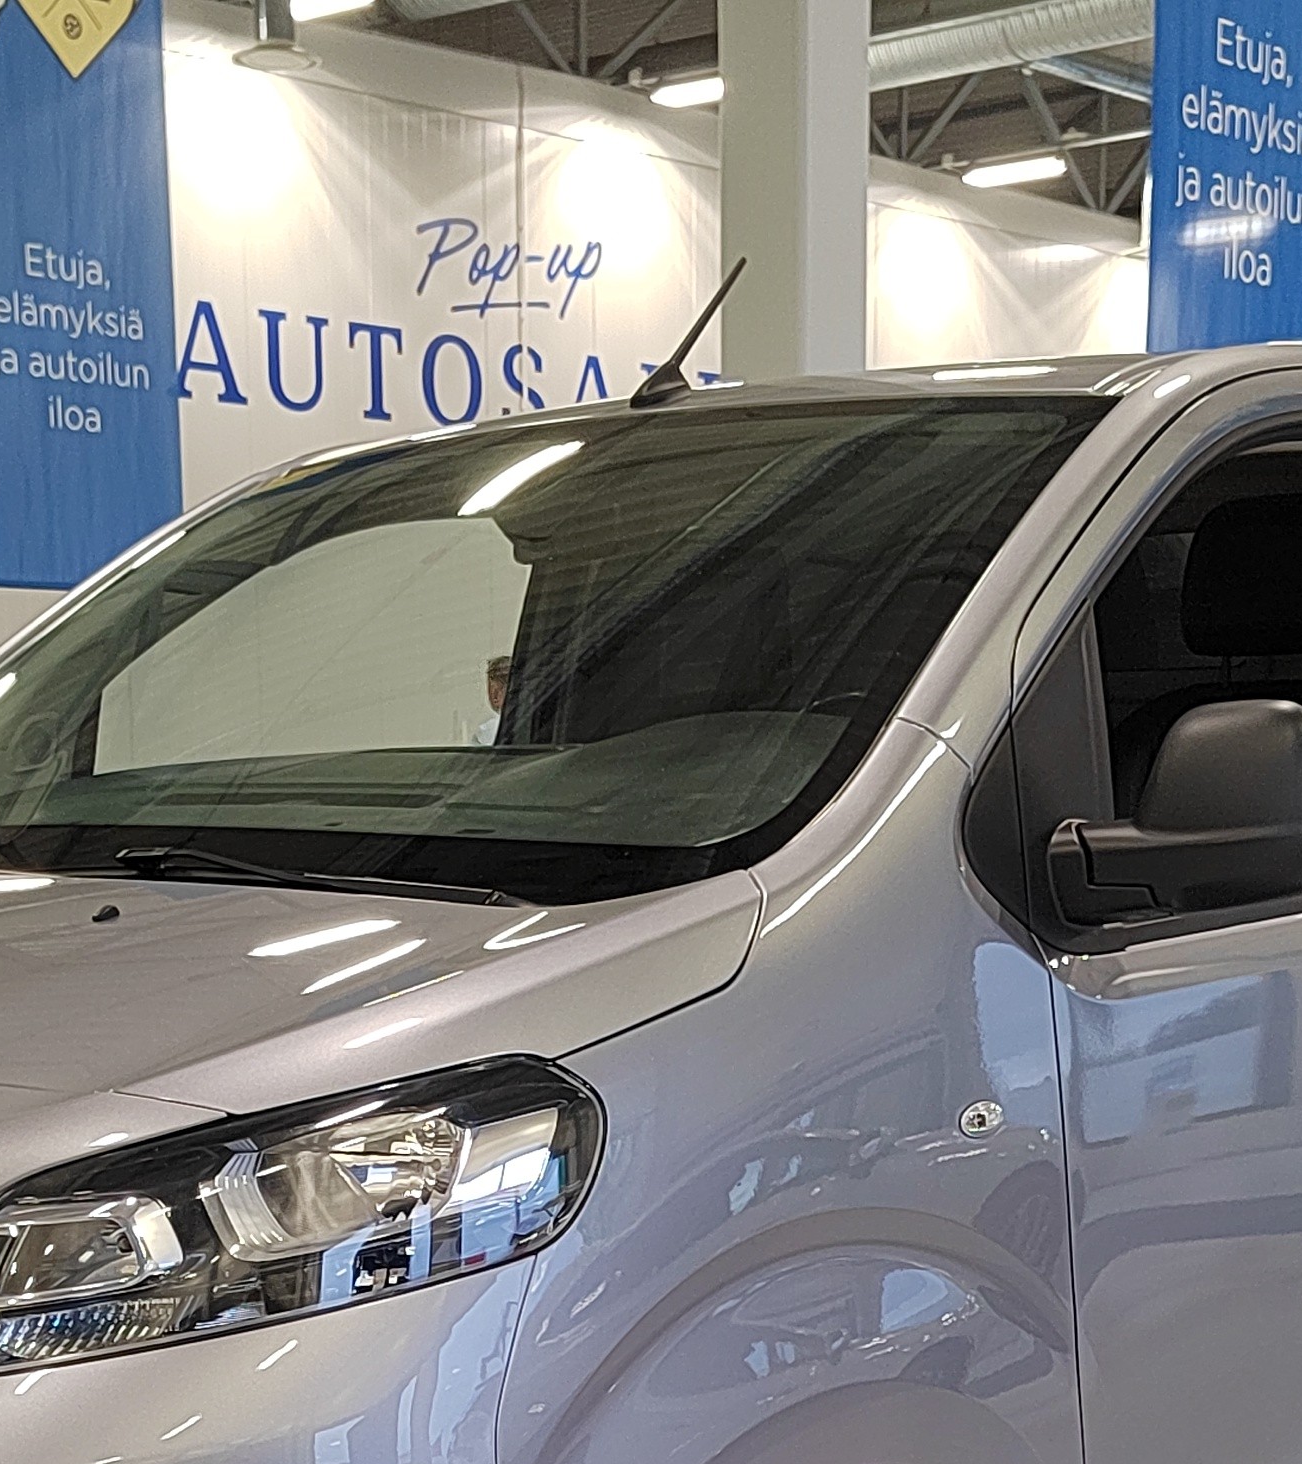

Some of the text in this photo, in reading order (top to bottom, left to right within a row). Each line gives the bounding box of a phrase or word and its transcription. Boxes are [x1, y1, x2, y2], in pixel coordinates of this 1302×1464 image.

[1216, 16, 1294, 89] Etuja,
[1174, 152, 1201, 207] ja
[23, 242, 111, 291] Etuja,
[416, 217, 603, 319] Pop-up
[1223, 240, 1273, 287] iloa
[29, 350, 151, 391] autoilun
[176, 299, 721, 426] AUTOSA
[48, 396, 102, 434] iloa
